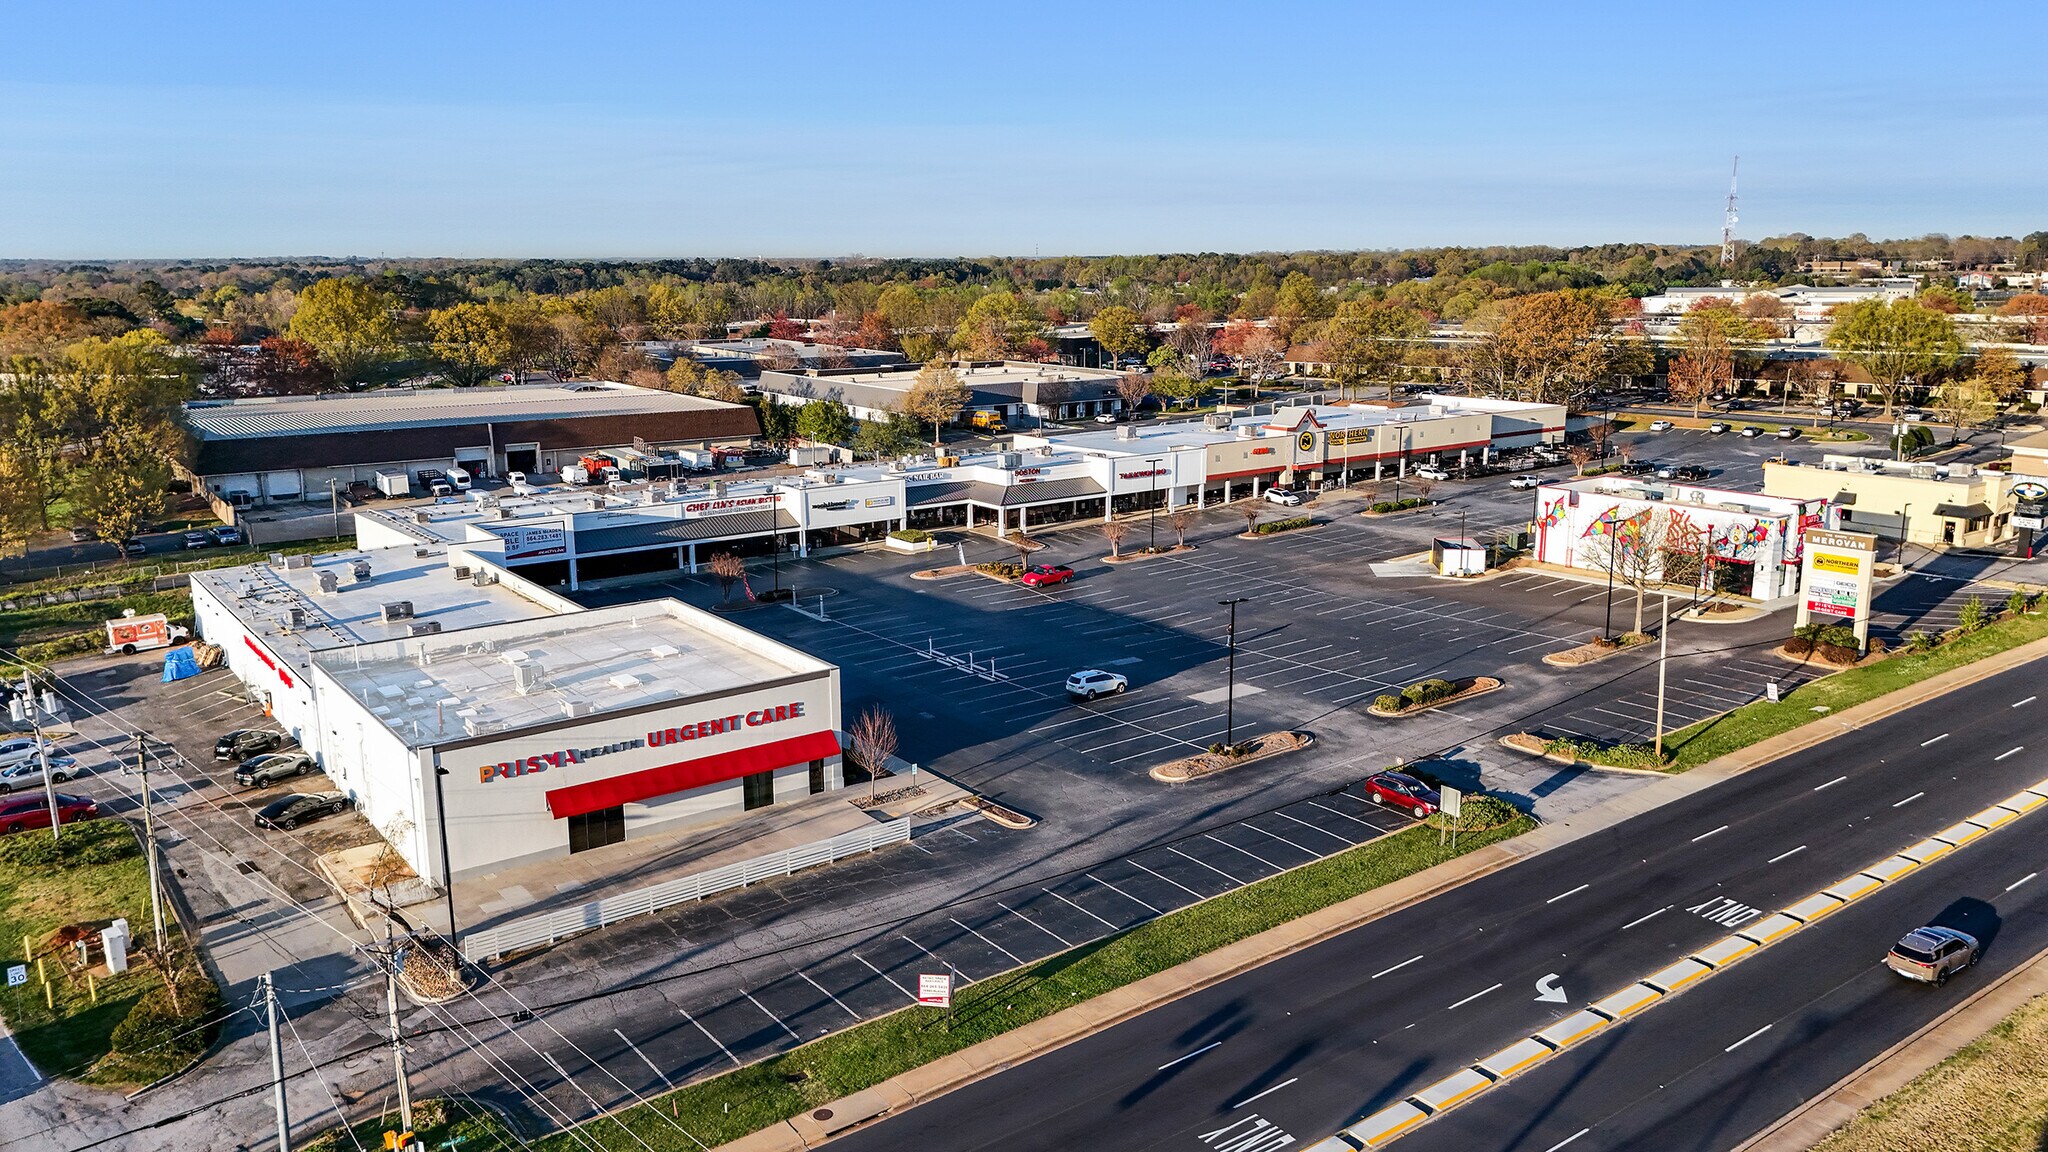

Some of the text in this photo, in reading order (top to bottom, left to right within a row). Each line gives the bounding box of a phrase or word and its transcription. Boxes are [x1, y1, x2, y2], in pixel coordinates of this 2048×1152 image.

[1014, 468, 1040, 476] BOSTON
[686, 501, 710, 512] CHEF
[1812, 536, 1865, 549] MEROVAN
[1826, 558, 1859, 568] NORTHERN
[647, 714, 742, 748] URGENT
[745, 702, 802, 727] CARE
[1685, 895, 1762, 928] ONLY
[11, 974, 24, 983] 30
